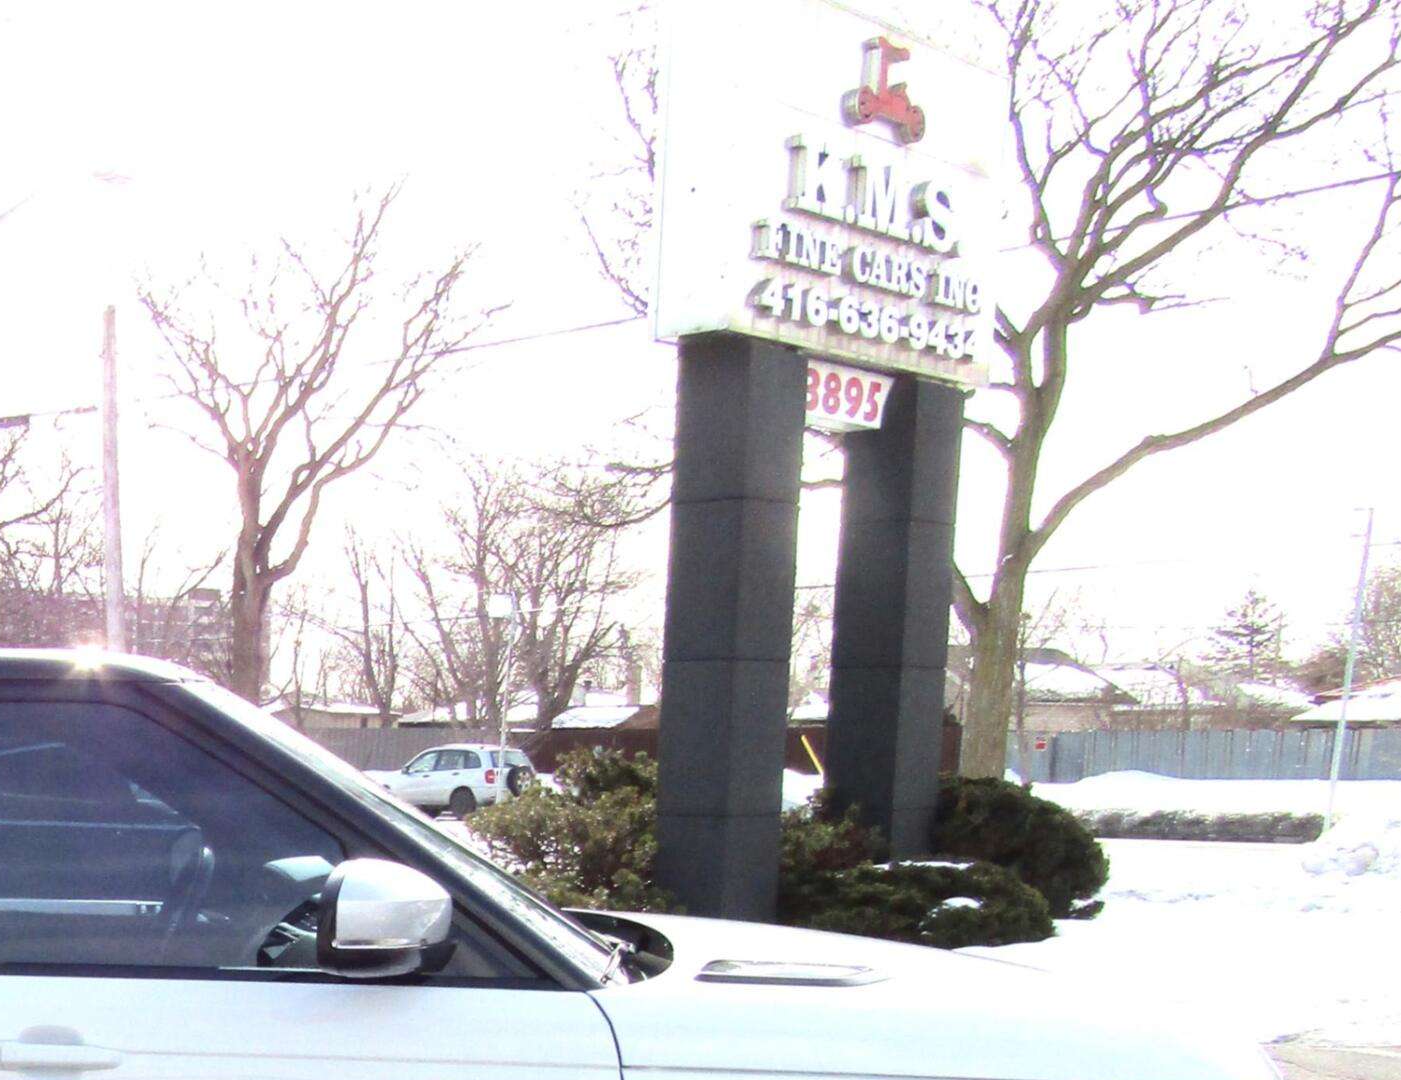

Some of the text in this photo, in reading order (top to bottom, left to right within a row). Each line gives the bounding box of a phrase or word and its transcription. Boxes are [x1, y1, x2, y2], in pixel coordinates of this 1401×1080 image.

[750, 217, 842, 276] FINE
[851, 244, 927, 298] CARS
[750, 274, 978, 360] 416-636-9434
